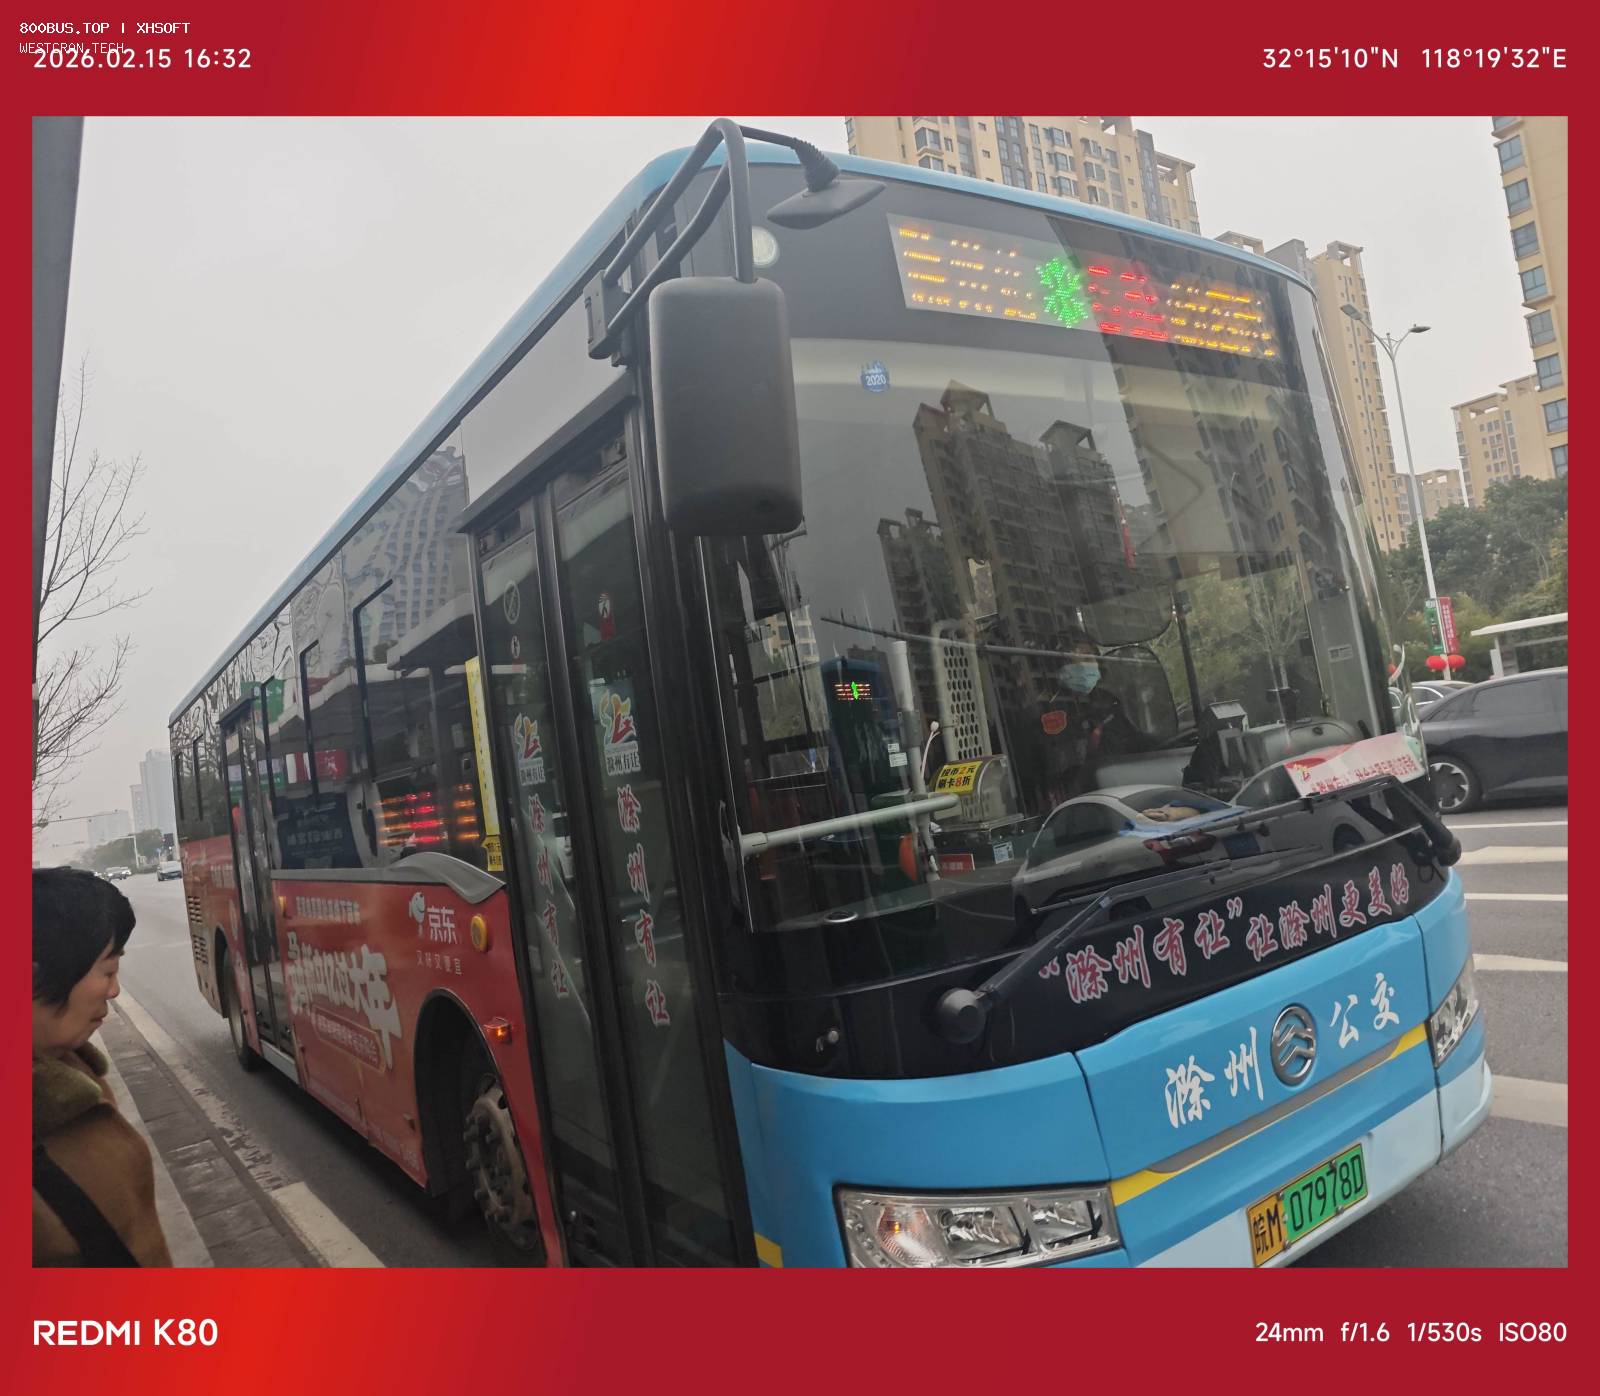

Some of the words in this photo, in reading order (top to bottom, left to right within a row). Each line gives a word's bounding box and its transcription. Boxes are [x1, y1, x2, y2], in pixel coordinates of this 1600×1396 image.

[865, 374, 887, 386] 2020
[426, 905, 458, 944] 京东
[1163, 1026, 1264, 1129] 滁州
[1329, 972, 1400, 1049] 公交
